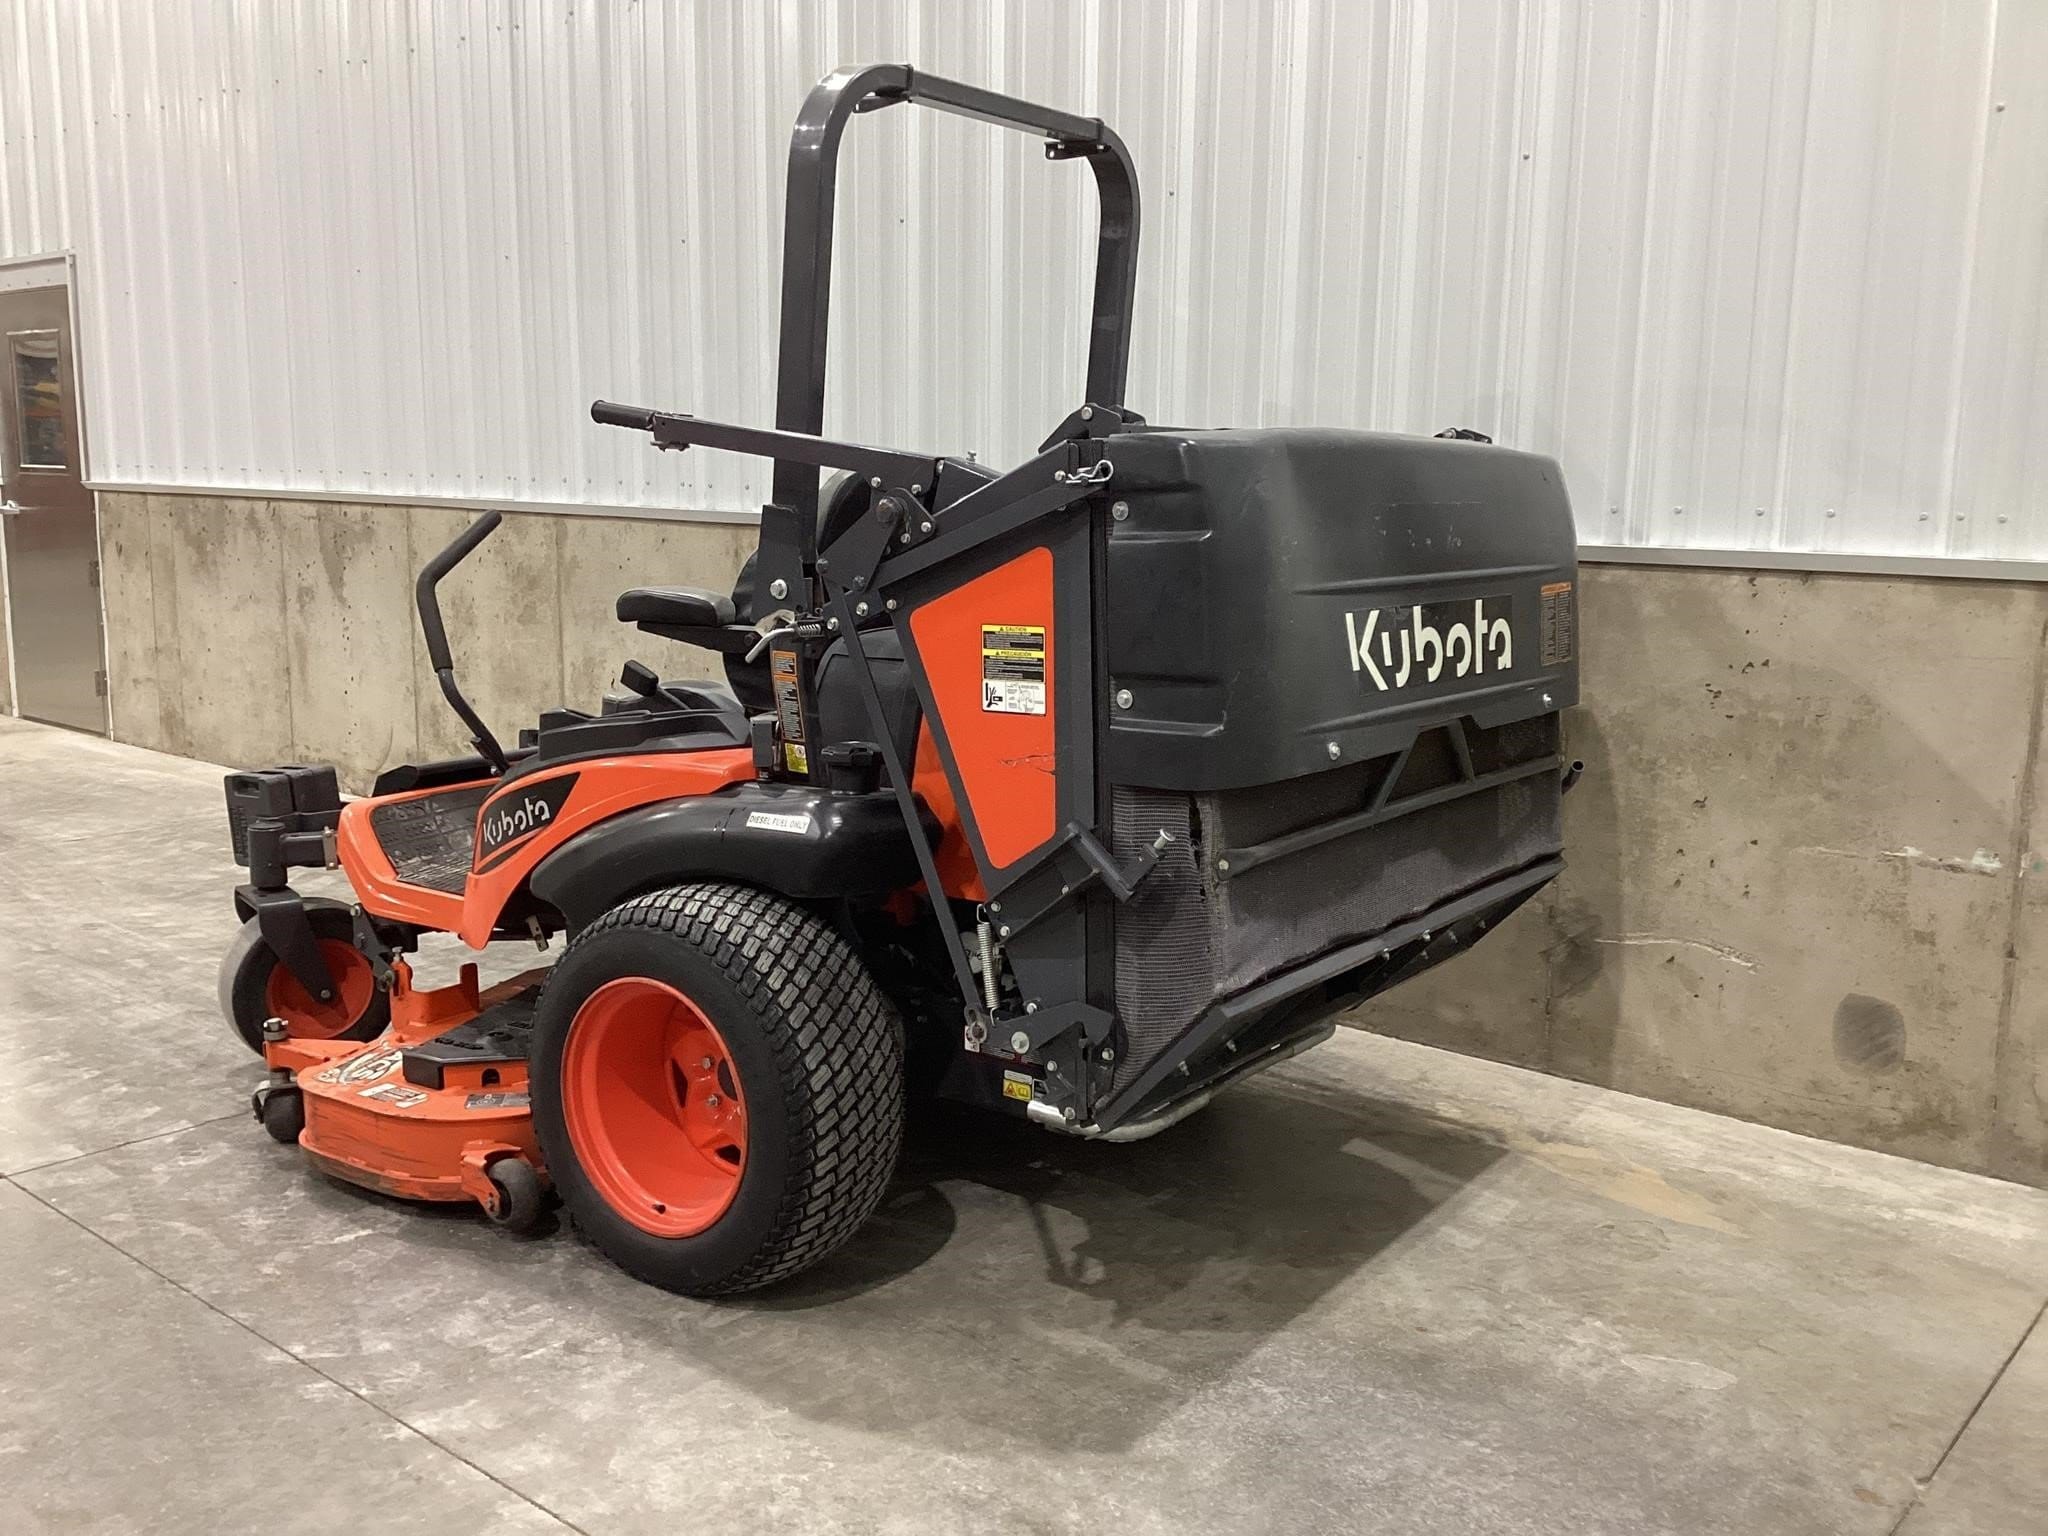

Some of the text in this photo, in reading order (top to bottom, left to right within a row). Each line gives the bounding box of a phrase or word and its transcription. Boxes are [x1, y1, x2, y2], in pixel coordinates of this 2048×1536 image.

[1345, 599, 1512, 691] Kubota
[483, 797, 550, 845] Kubota
[749, 815, 807, 831] DIESEL FUEL ONLY
